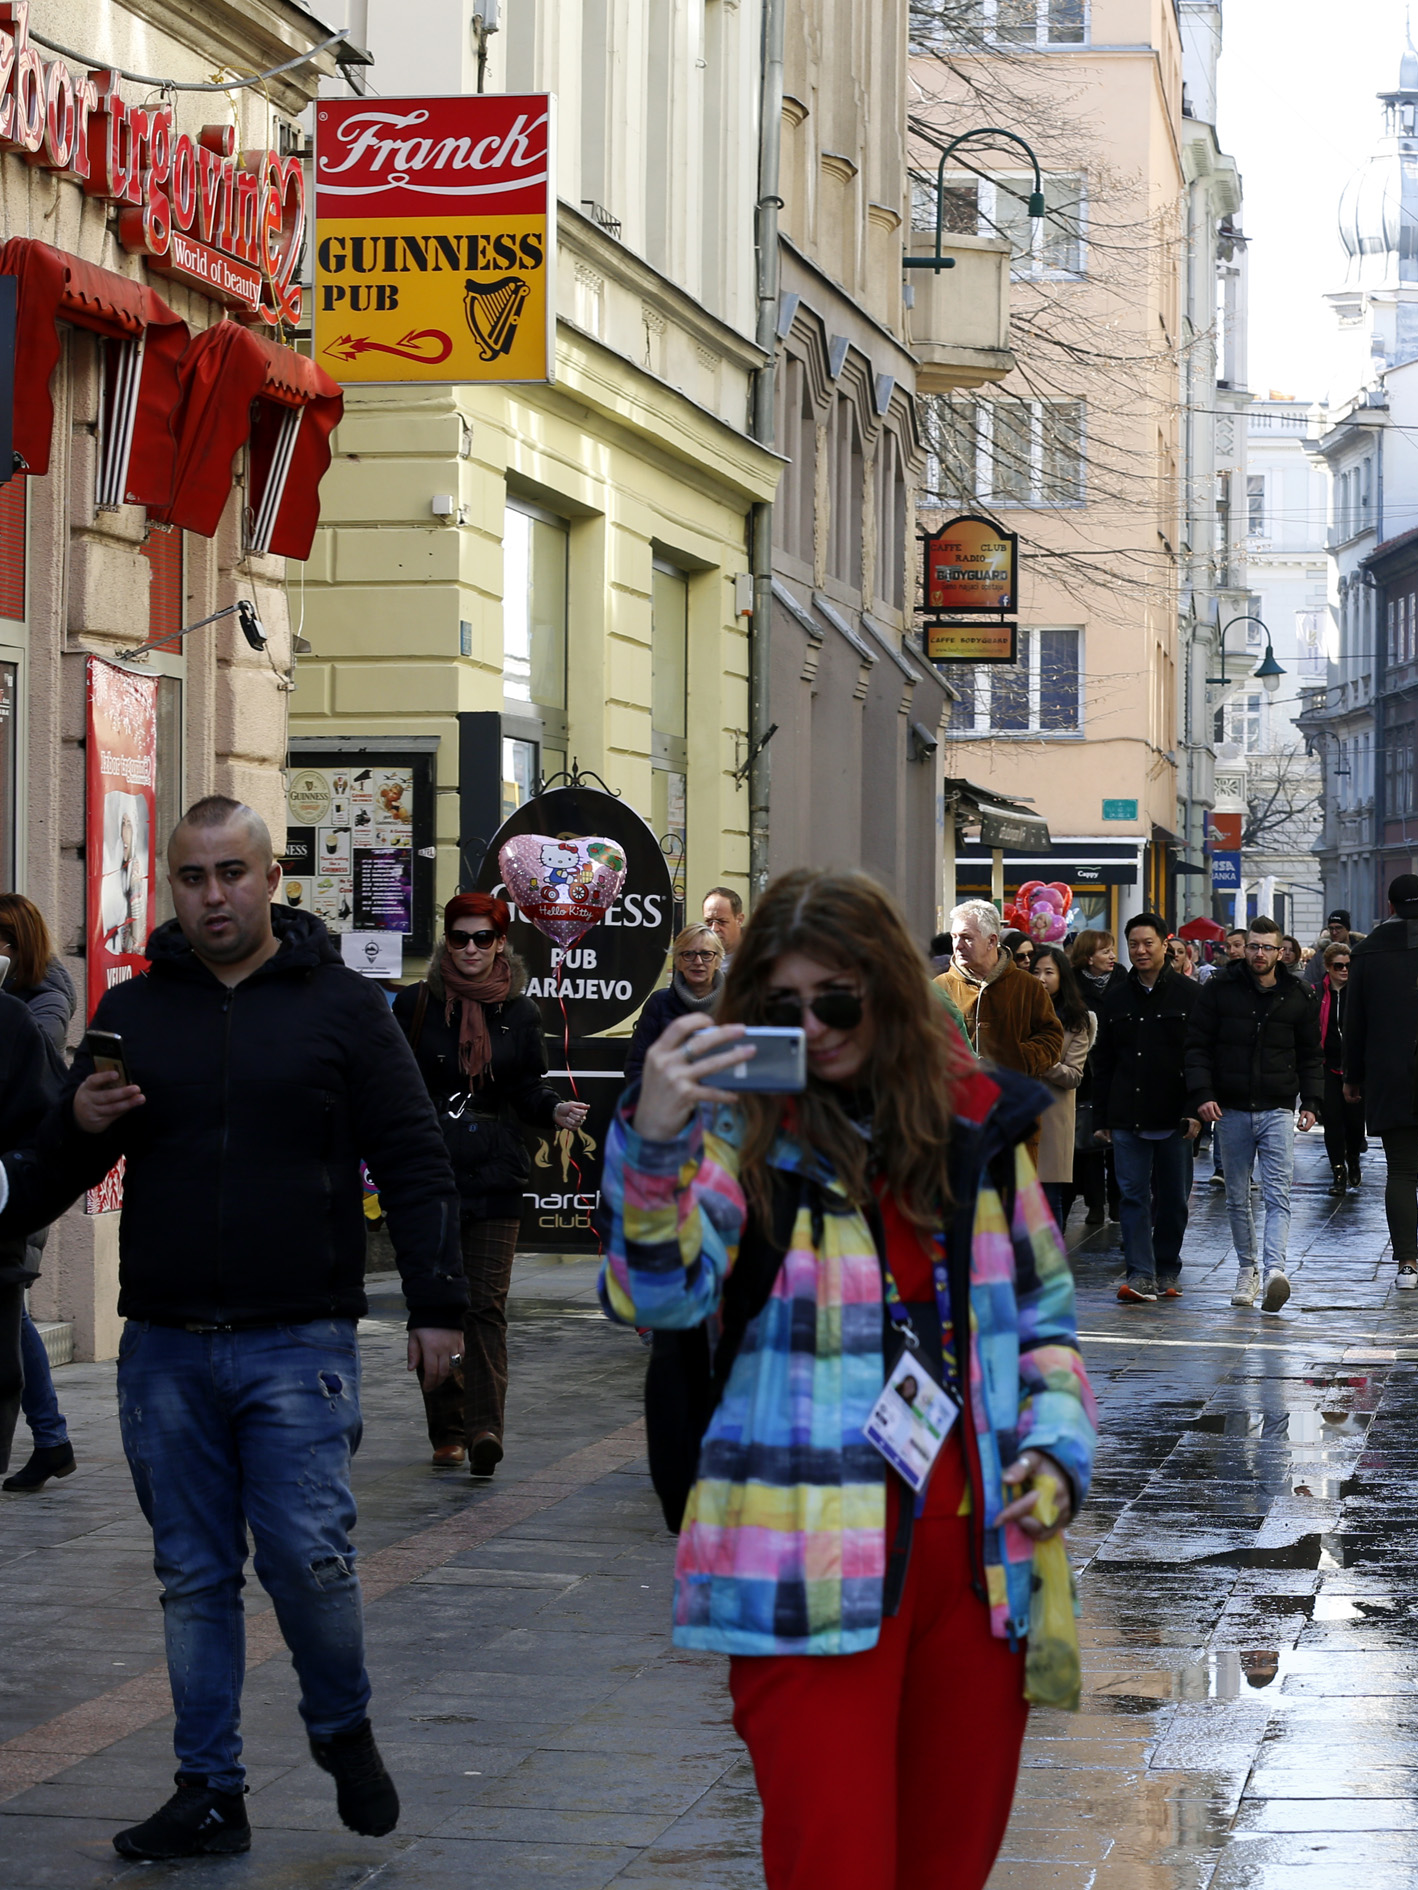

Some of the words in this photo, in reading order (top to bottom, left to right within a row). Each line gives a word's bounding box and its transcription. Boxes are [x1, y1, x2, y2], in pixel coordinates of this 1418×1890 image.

[319, 109, 549, 173] Franck
[105, 70, 283, 278] trgovine
[318, 233, 544, 274] GUINNESS
[174, 236, 208, 277] World
[210, 259, 223, 284] of
[223, 262, 260, 308] beauty
[322, 285, 400, 312] PUB
[930, 543, 962, 552] CAFFE
[980, 543, 1007, 552] CLUB
[955, 554, 986, 563] RADIO
[290, 791, 329, 801] GUINNESS
[539, 904, 567, 916] Hello
[569, 904, 593, 922] Kitty
[551, 948, 597, 969] PUB
[520, 977, 633, 1001] ARAJEVO
[538, 1213, 592, 1229] club
